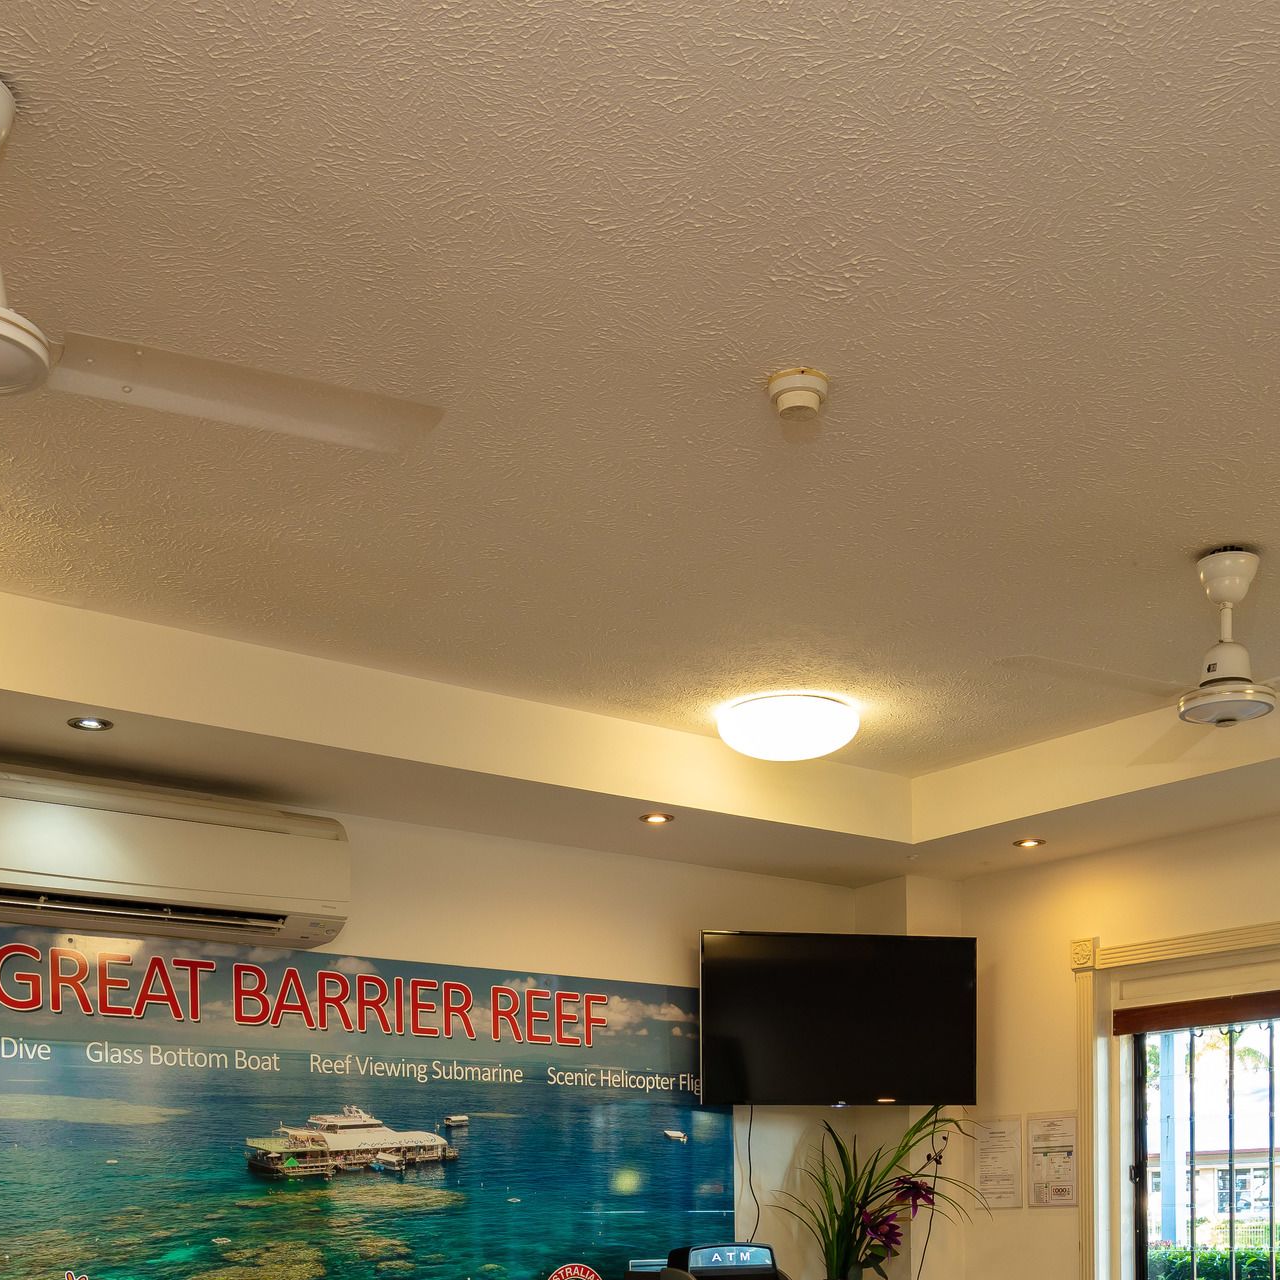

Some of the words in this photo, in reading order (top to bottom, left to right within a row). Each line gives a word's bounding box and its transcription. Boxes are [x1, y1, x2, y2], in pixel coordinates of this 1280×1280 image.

[232, 962, 476, 1040] BARRIER
[491, 984, 608, 1048] REEF
[1, 1036, 52, 1061] Dive
[86, 1041, 143, 1065] Glass
[150, 1045, 229, 1070] Bottom
[234, 1050, 280, 1072] Boat
[310, 1053, 351, 1075] Reef
[355, 1056, 428, 1083] Viewing
[432, 1061, 524, 1084] Submarine
[548, 1066, 596, 1089] Scenic
[600, 1069, 676, 1092] Helicopter
[679, 1073, 702, 1096] Flig
[712, 1252, 751, 1262] ATM
